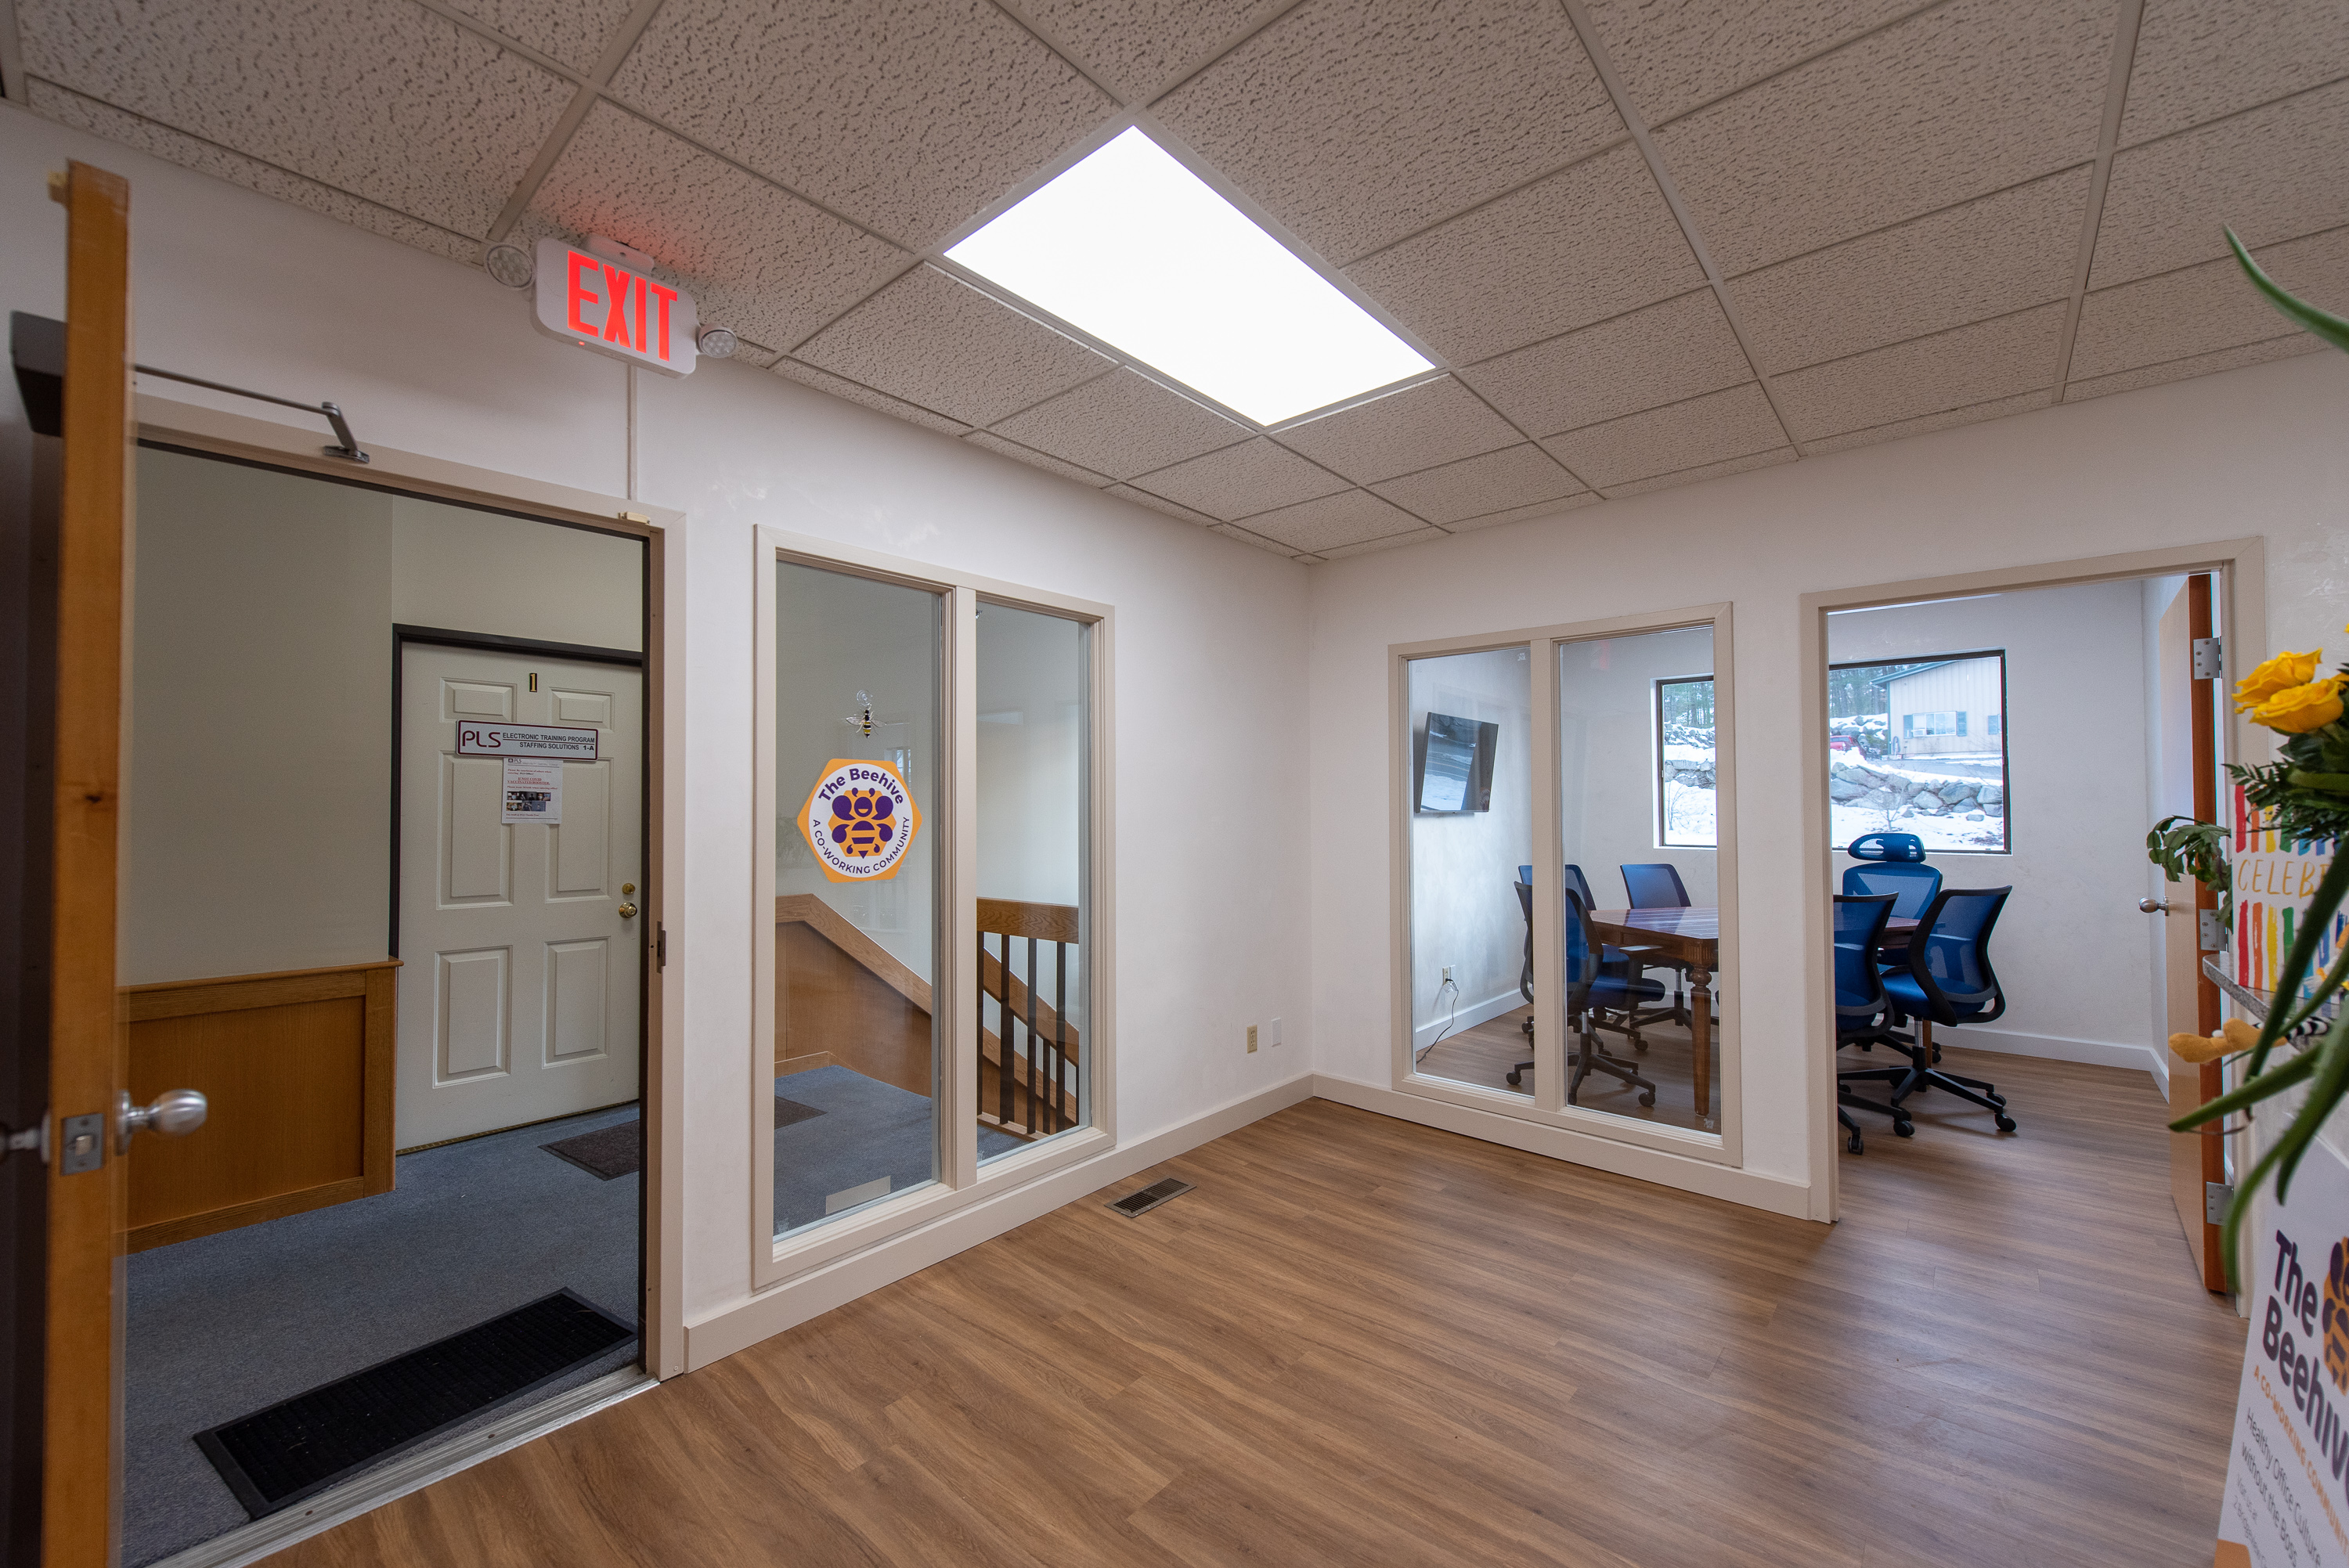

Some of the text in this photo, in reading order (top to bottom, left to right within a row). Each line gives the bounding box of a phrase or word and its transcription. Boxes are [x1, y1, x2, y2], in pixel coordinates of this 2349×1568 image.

[568, 251, 677, 362] EXIT
[529, 673, 537, 692] 1
[462, 730, 501, 748] PLS
[818, 768, 904, 805] The Beehive
[813, 816, 910, 874] A CO-WORKING COMMUNITY
[2275, 1229, 2318, 1338] The
[2263, 1295, 2349, 1509] Beehiv
[2242, 1442, 2297, 1567] without the Boss
[2246, 1408, 2321, 1568] Healthy Office Culture
[2253, 1365, 2349, 1566] A CO-WORKING COMMUNIT
